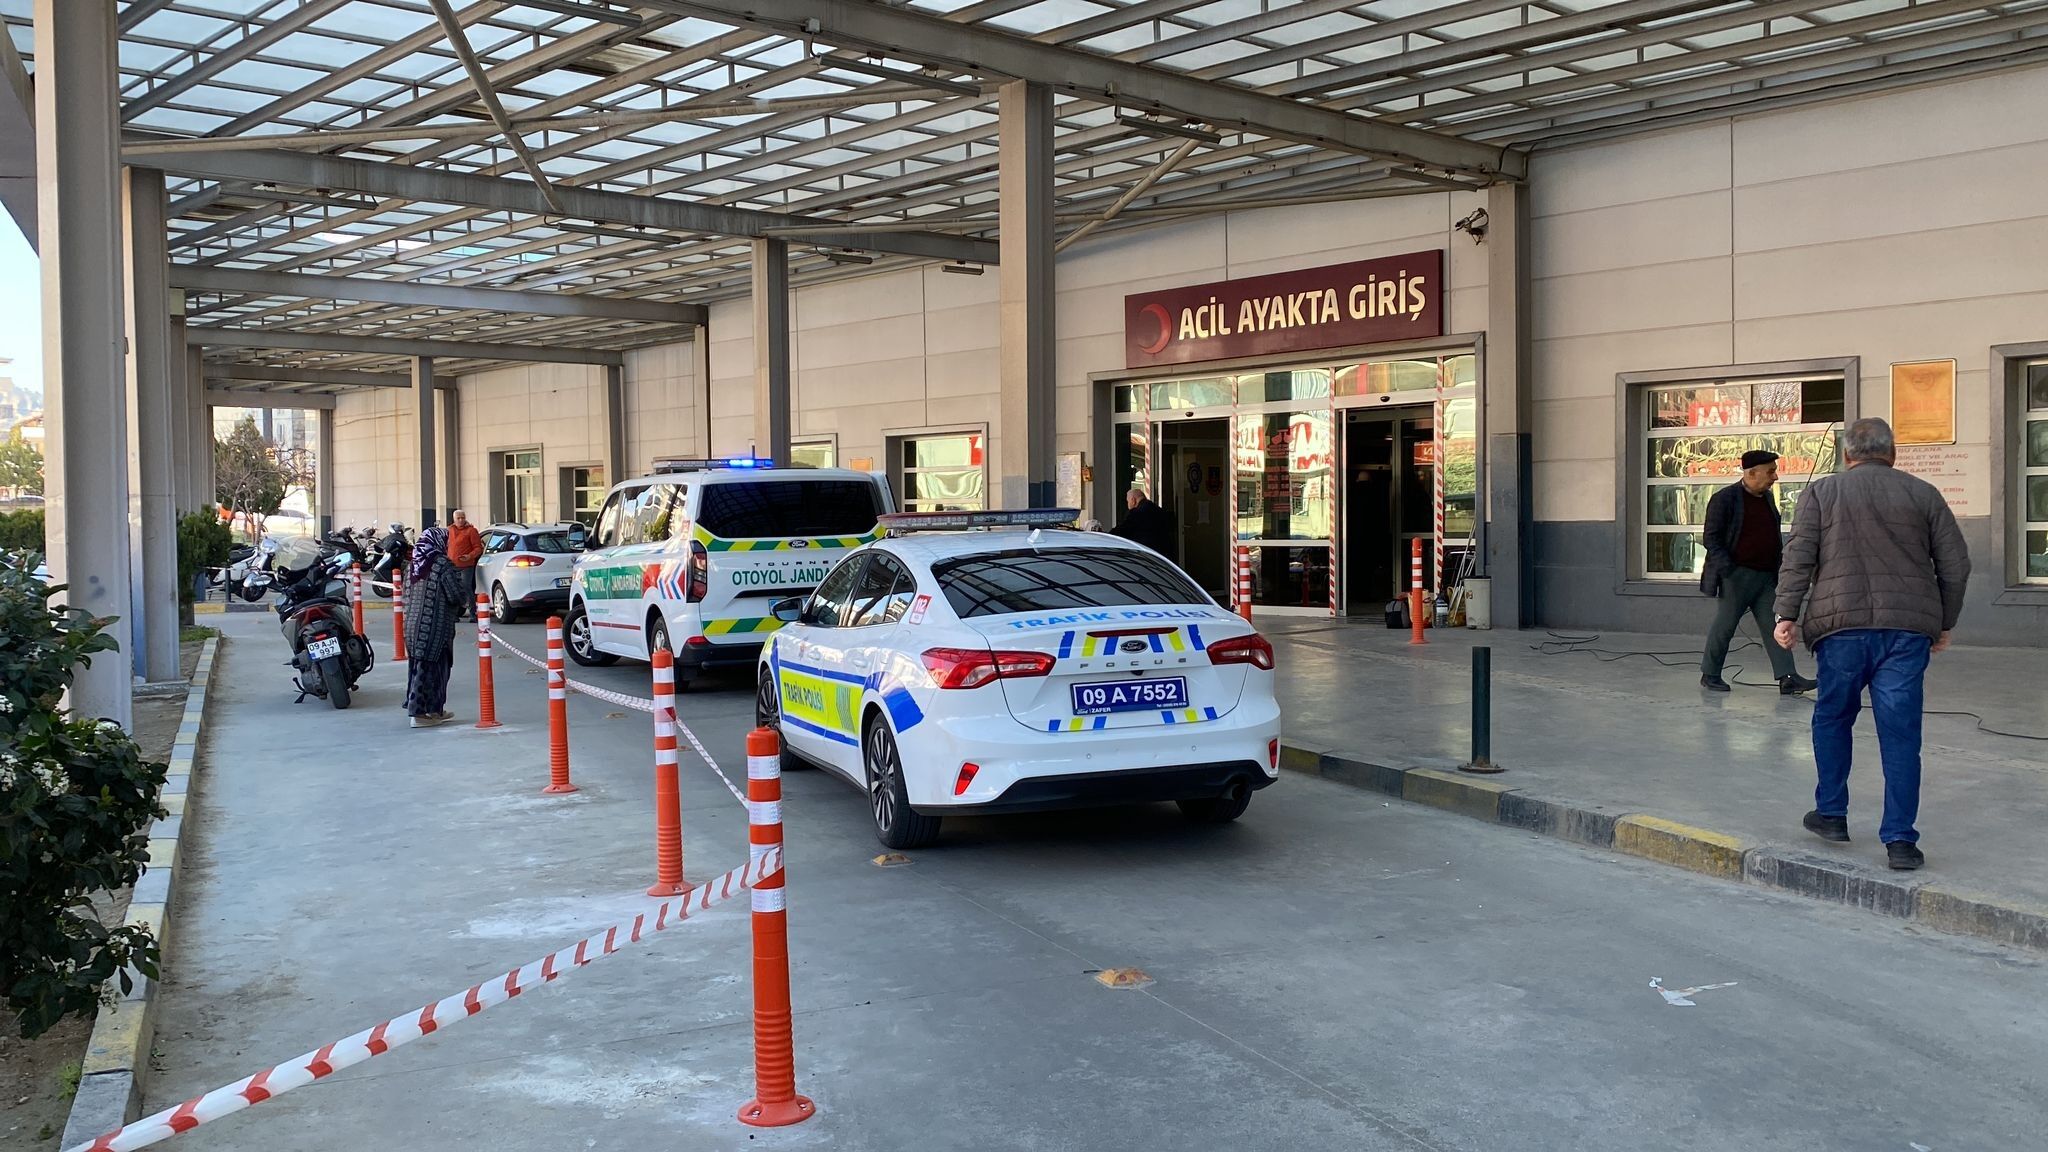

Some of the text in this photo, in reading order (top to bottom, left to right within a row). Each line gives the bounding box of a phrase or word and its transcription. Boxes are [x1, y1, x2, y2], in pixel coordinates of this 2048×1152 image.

[1178, 269, 1427, 341] ACİL AYAKTA GİRİŞ
[732, 570, 786, 586] OTOYOL
[1008, 612, 1112, 629] TRAFİK
[309, 638, 337, 651] 09 AJH
[320, 646, 335, 655] 997
[1079, 658, 1187, 669] FOCUS
[784, 681, 824, 712] TRAFİK POLİSİ
[1083, 683, 1178, 706] 09 A 7552
